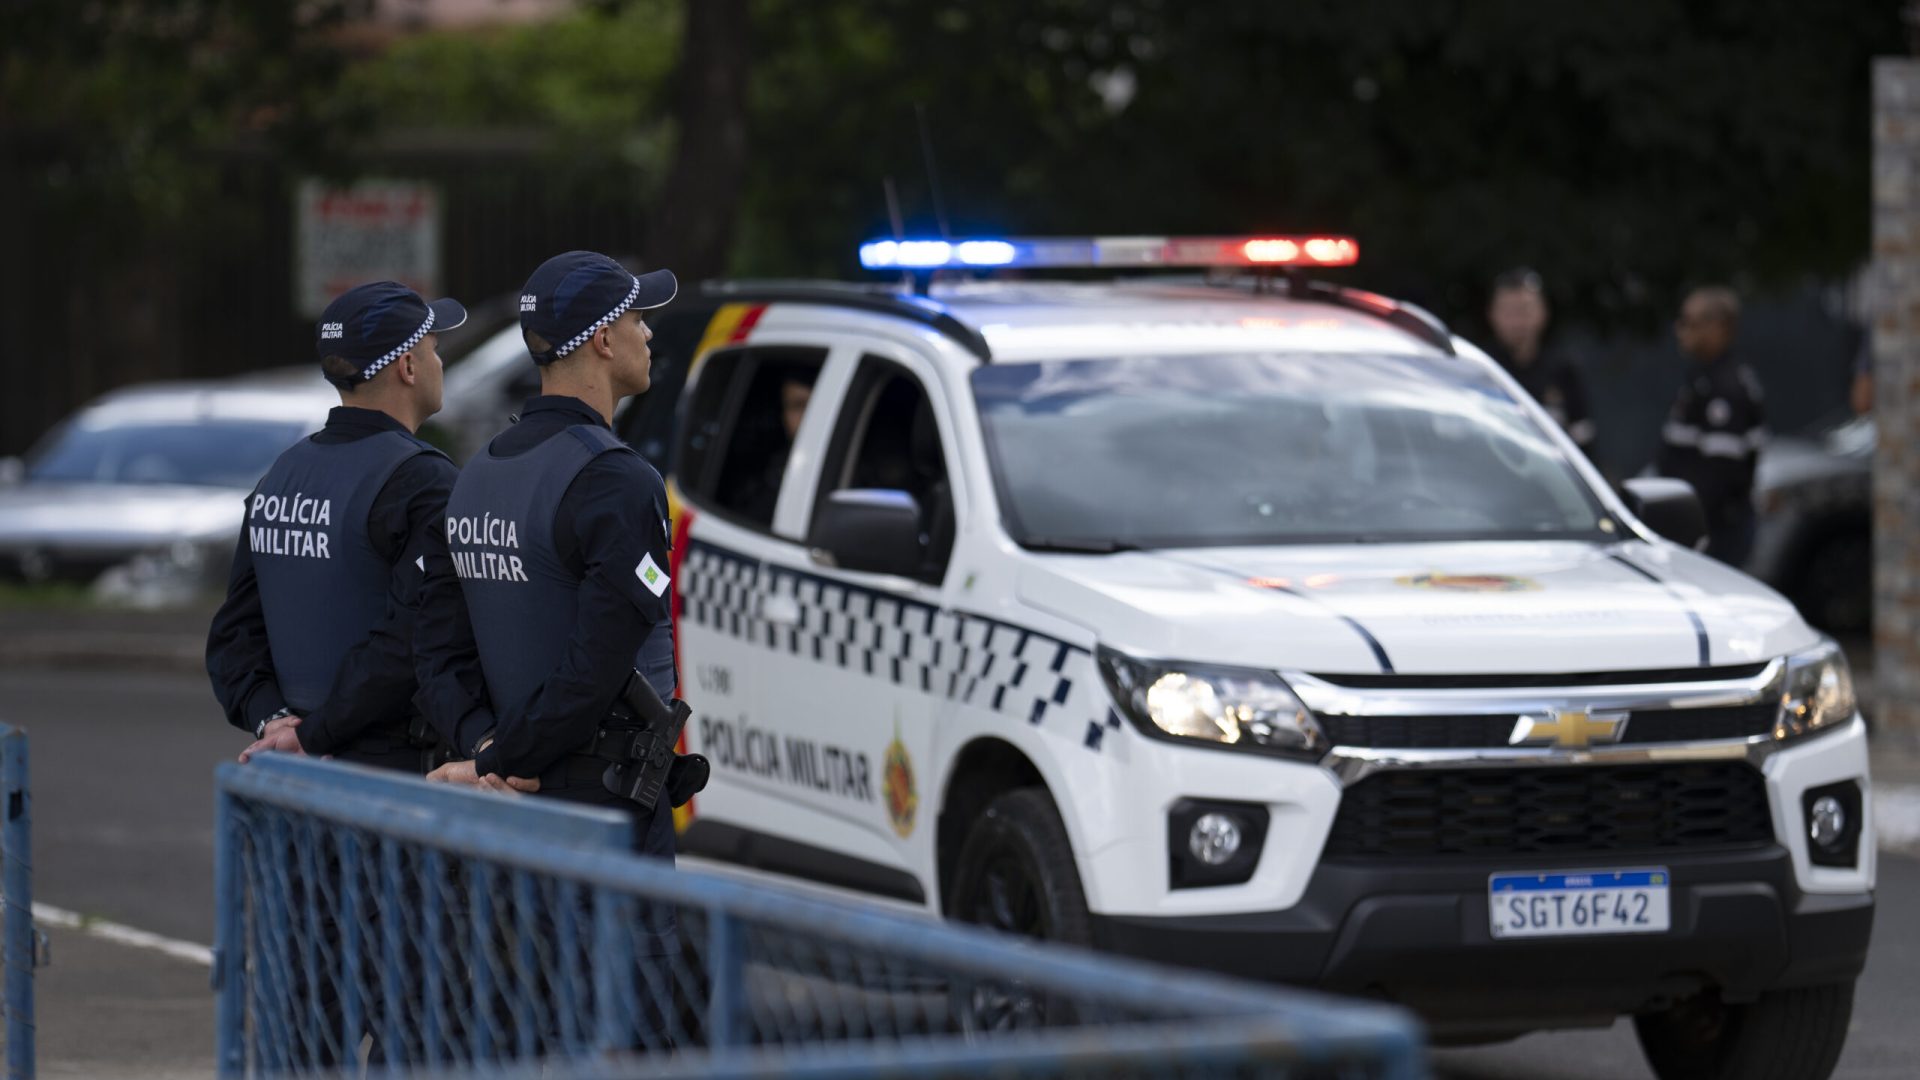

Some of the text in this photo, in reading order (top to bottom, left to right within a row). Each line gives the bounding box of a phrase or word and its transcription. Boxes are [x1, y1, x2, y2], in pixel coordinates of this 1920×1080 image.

[250, 492, 331, 526] POLÍCIA
[249, 526, 331, 559] MILITAR
[447, 511, 519, 548] POLÍCIA
[451, 552, 529, 582] MILITAR
[700, 713, 875, 801] POLÍCIA MILITAR
[1509, 892, 1650, 929] SGT6F42
